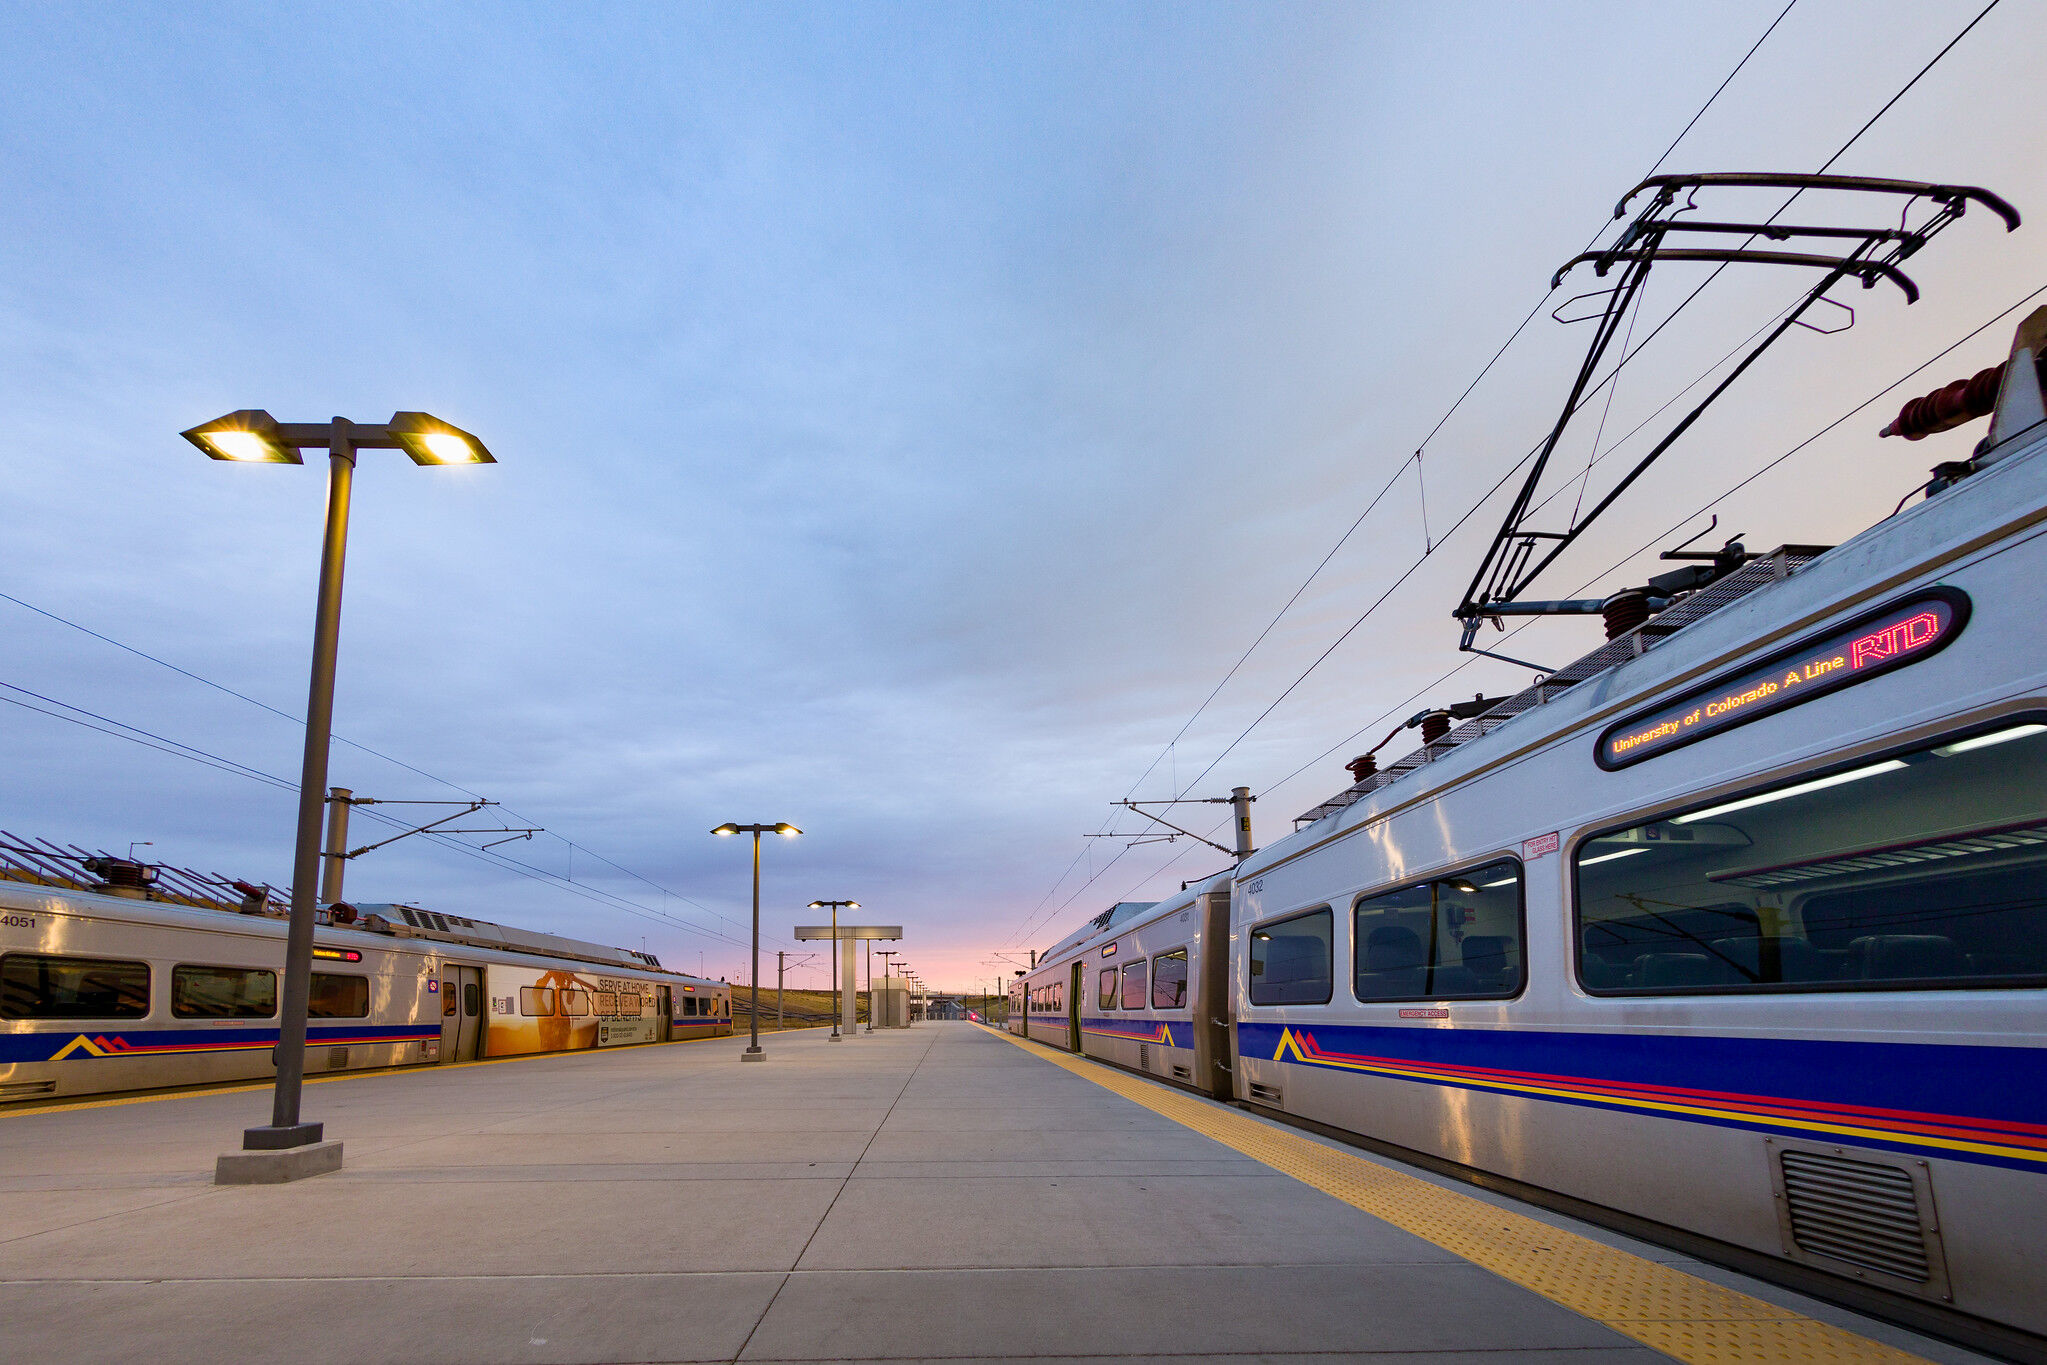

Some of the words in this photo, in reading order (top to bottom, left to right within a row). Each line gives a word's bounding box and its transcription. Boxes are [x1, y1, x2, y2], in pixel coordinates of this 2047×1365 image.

[1613, 719, 1679, 754] University
[1684, 708, 1701, 727] of
[1706, 681, 1777, 717] Colorado
[1783, 670, 1802, 688] A
[1805, 655, 1844, 680] Line
[1851, 612, 1939, 669] RTD
[1247, 879, 1263, 895] 4032
[0, 915, 35, 929] 4051
[599, 979, 621, 992] SERVE
[622, 981, 631, 993] AT
[599, 994, 628, 1008] RECEVE
